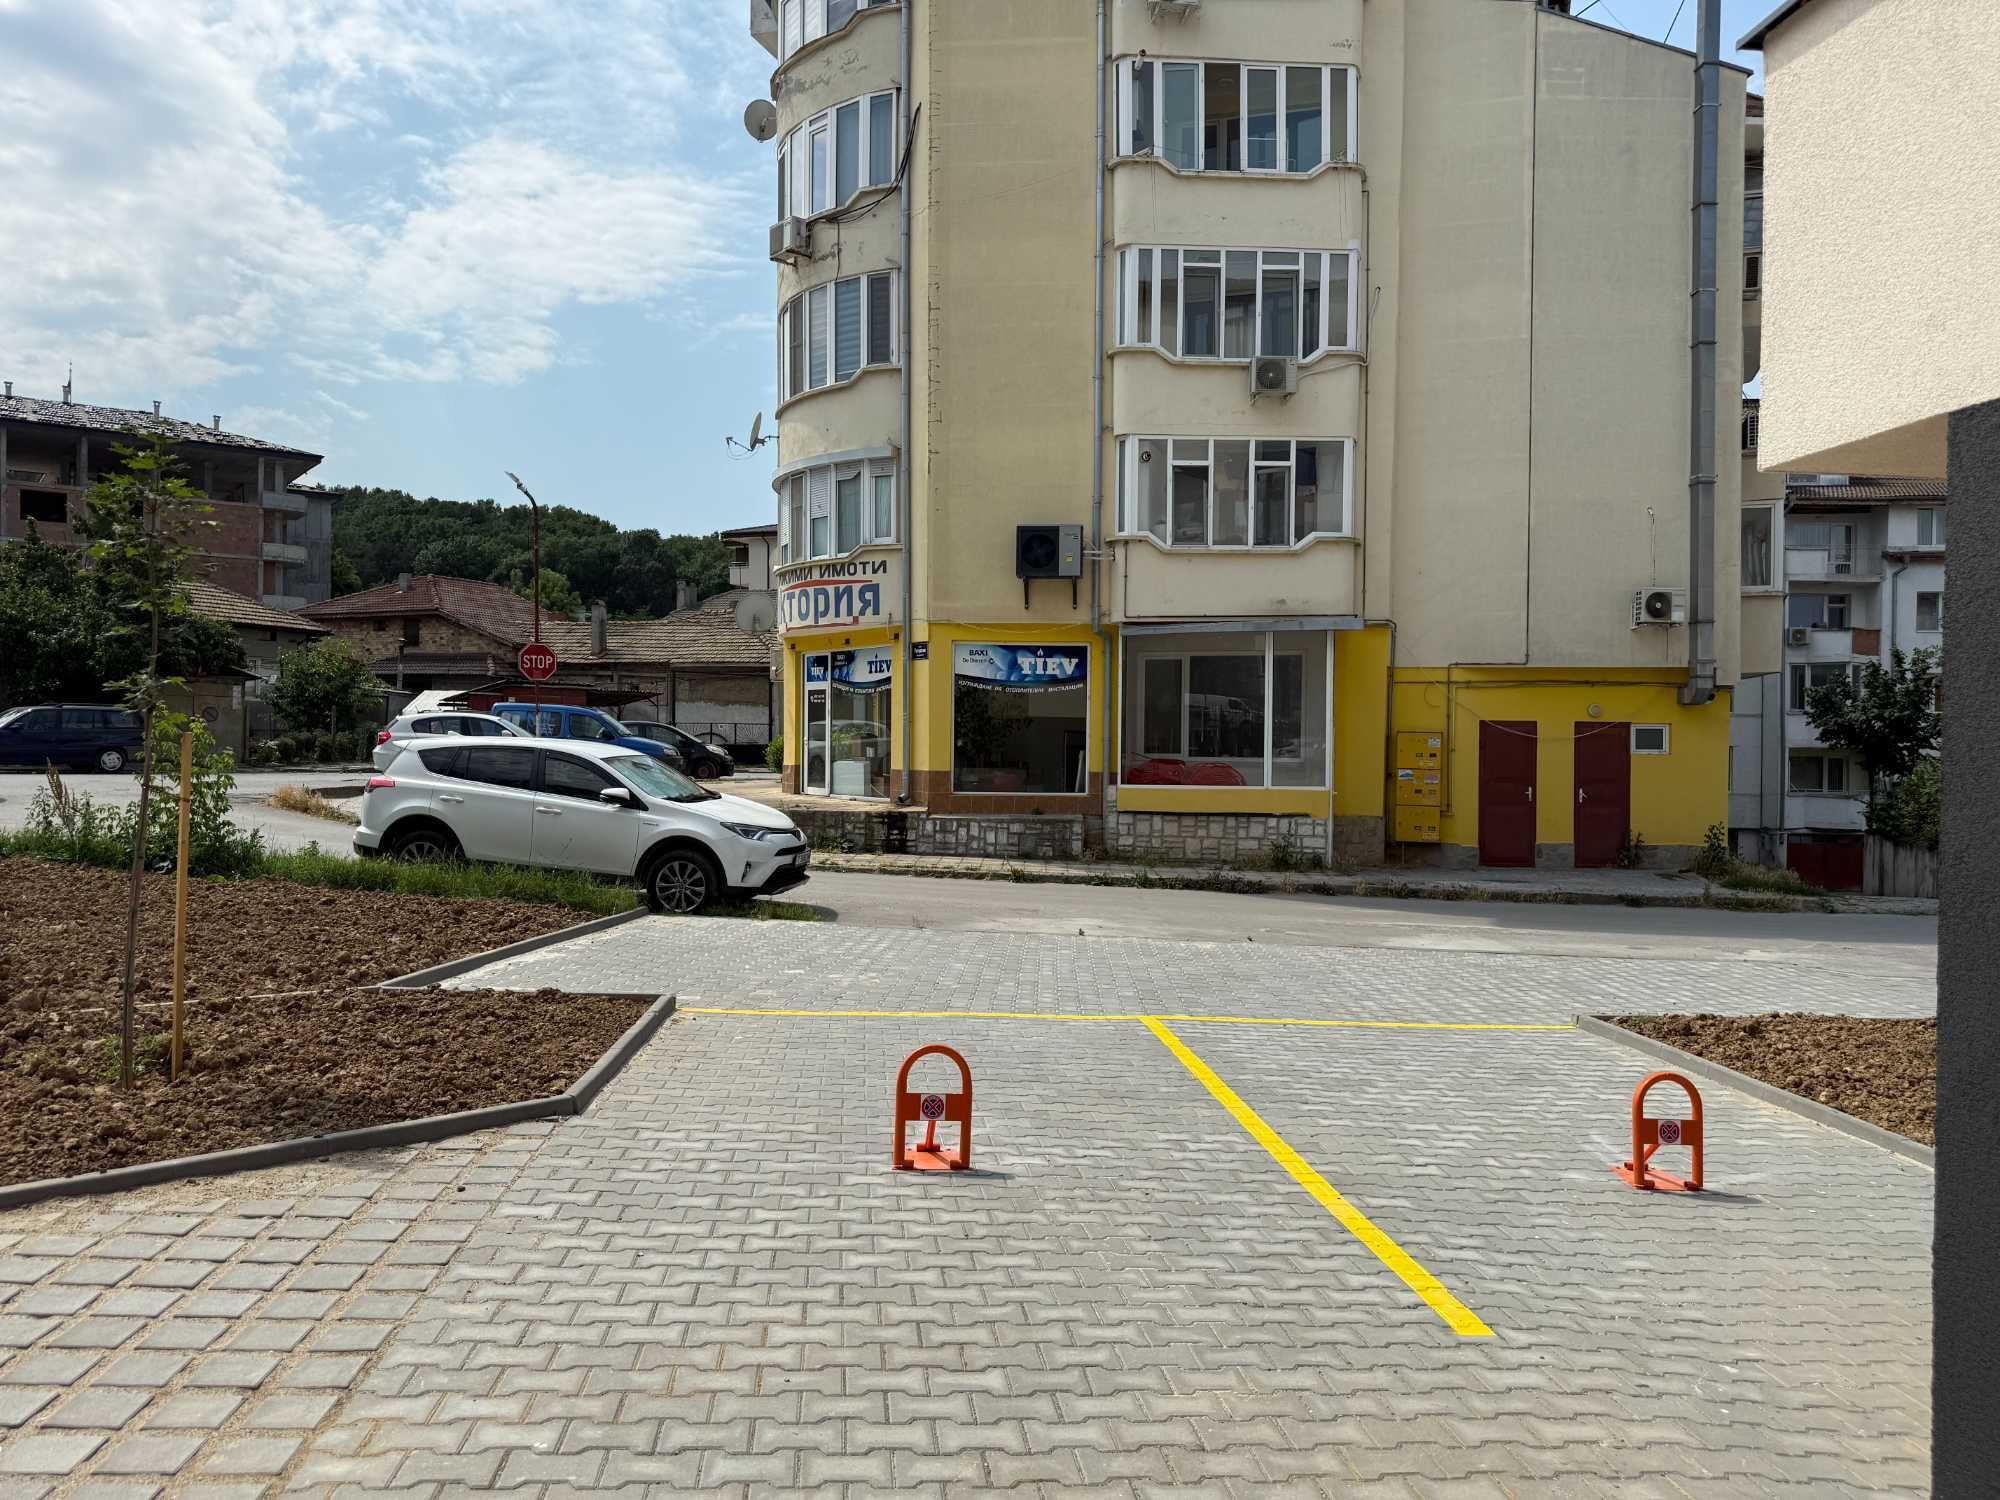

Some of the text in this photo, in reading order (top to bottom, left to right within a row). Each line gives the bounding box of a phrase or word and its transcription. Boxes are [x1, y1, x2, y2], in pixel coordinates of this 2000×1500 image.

[820, 560, 887, 578] ИМОТИ
[523, 655, 553, 669] STOP
[1018, 657, 1079, 675] TIEV
